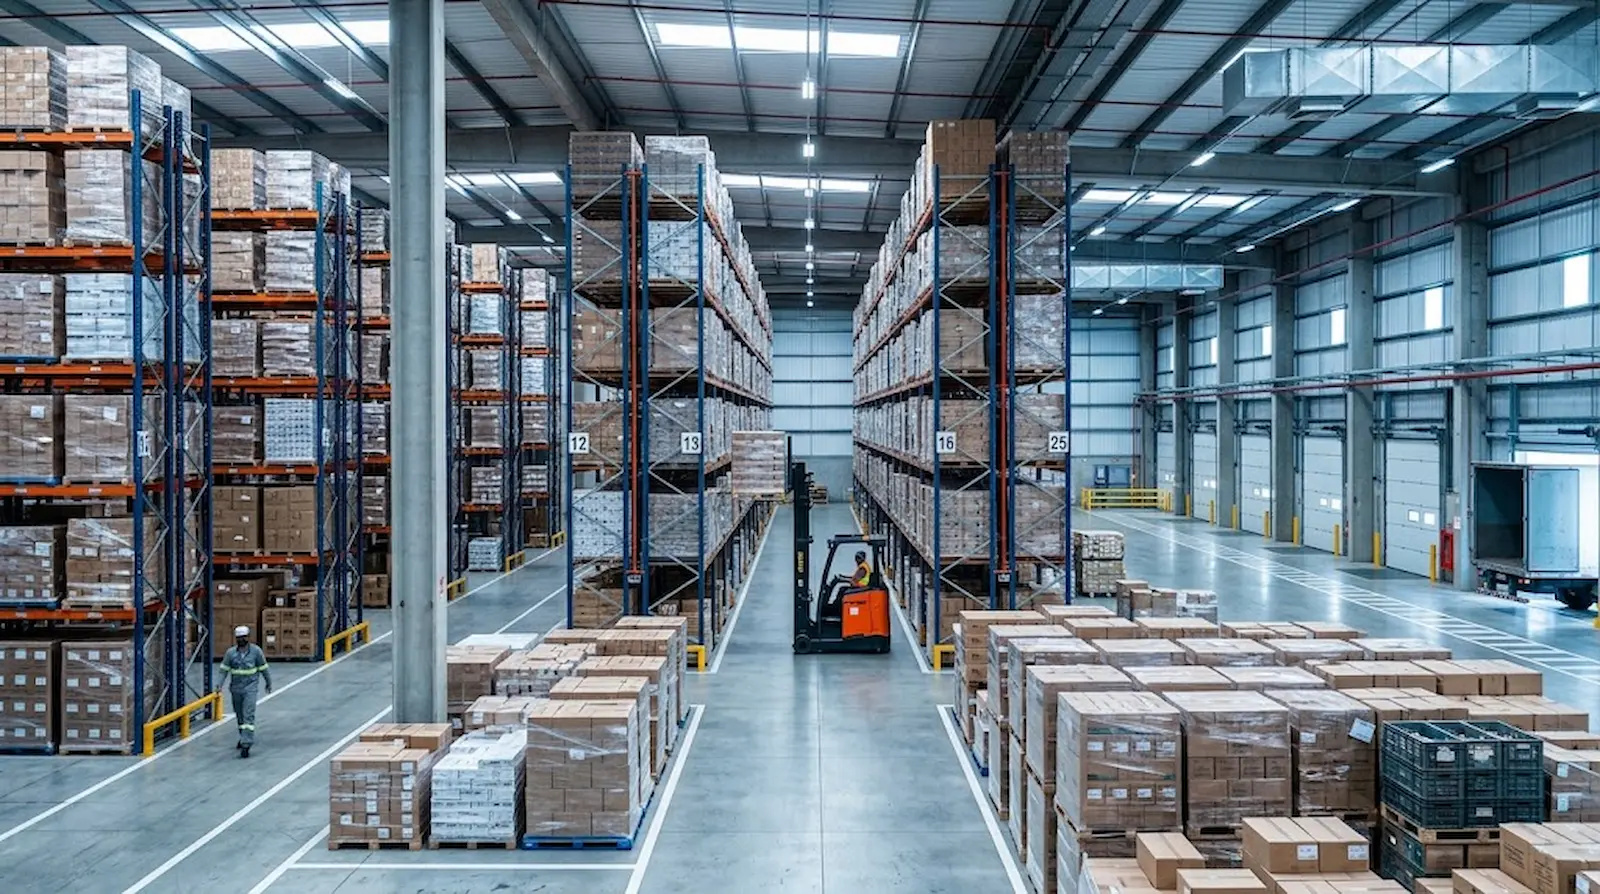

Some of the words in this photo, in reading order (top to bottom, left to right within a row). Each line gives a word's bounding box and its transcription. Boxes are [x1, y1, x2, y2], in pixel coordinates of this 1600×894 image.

[572, 436, 586, 450] 12
[684, 436, 699, 450] 13
[939, 436, 954, 450] 16
[1051, 435, 1067, 450] 25
